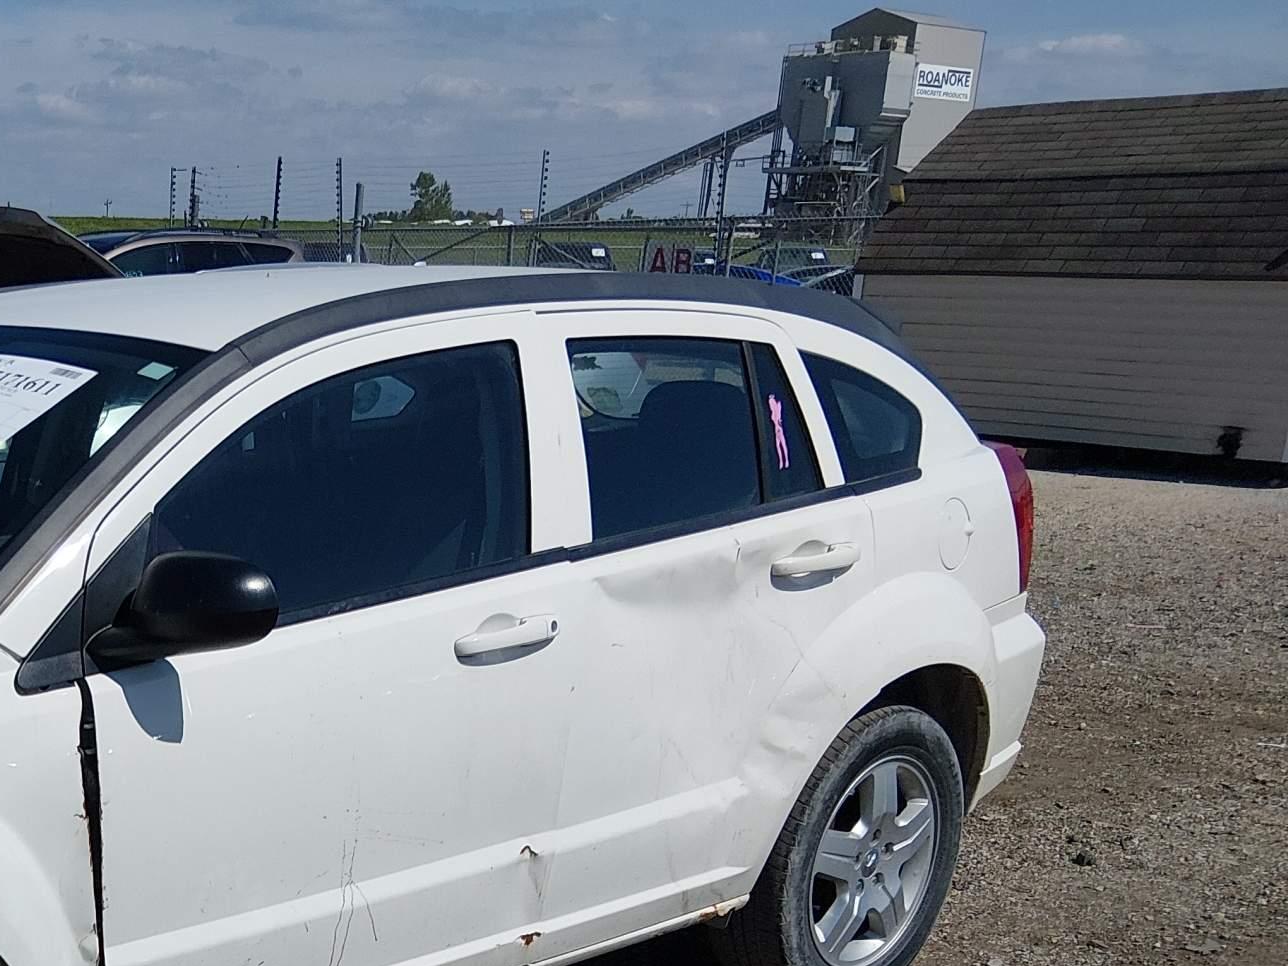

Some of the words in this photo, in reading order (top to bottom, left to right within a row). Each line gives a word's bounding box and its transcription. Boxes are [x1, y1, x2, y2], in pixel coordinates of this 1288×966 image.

[918, 70, 971, 88] ROANOKE
[916, 88, 942, 97] CONCRETE
[942, 92, 968, 100] PRODUCTS
